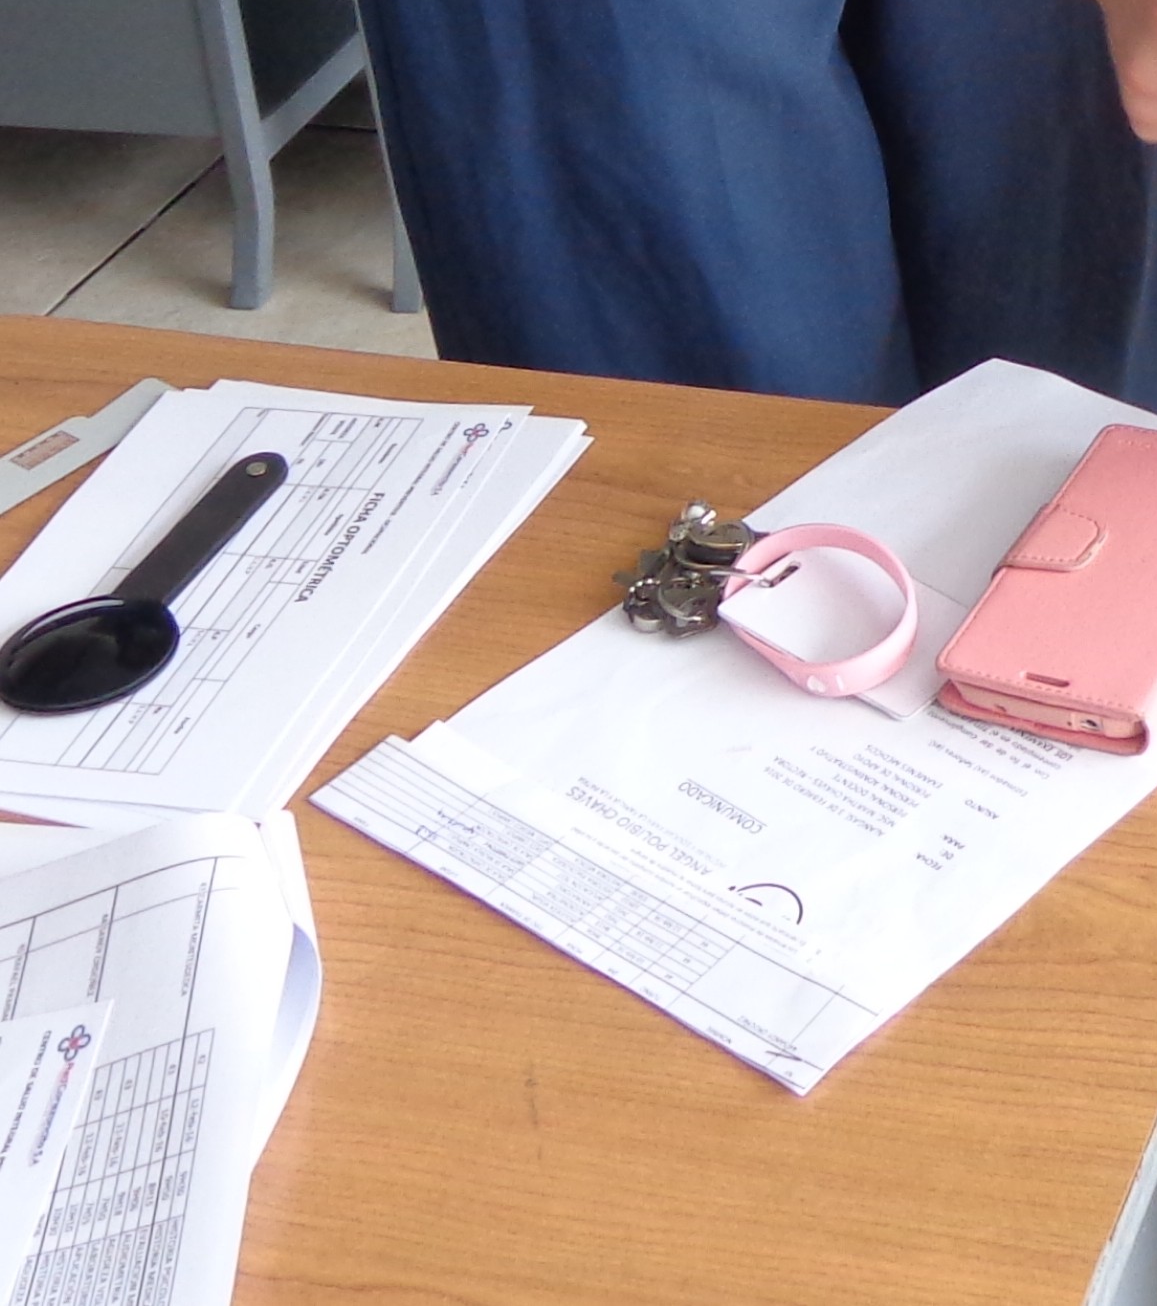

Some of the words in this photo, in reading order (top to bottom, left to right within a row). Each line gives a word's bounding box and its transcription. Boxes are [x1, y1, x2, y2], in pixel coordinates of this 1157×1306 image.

[351, 492, 387, 523] FICHA
[290, 525, 365, 603] OPTOMÉTRICA
[562, 784, 622, 821] CHAVES
[670, 778, 769, 836] COMUNICADO
[611, 814, 672, 852] POLIBIO
[665, 846, 715, 877] ANGEL
